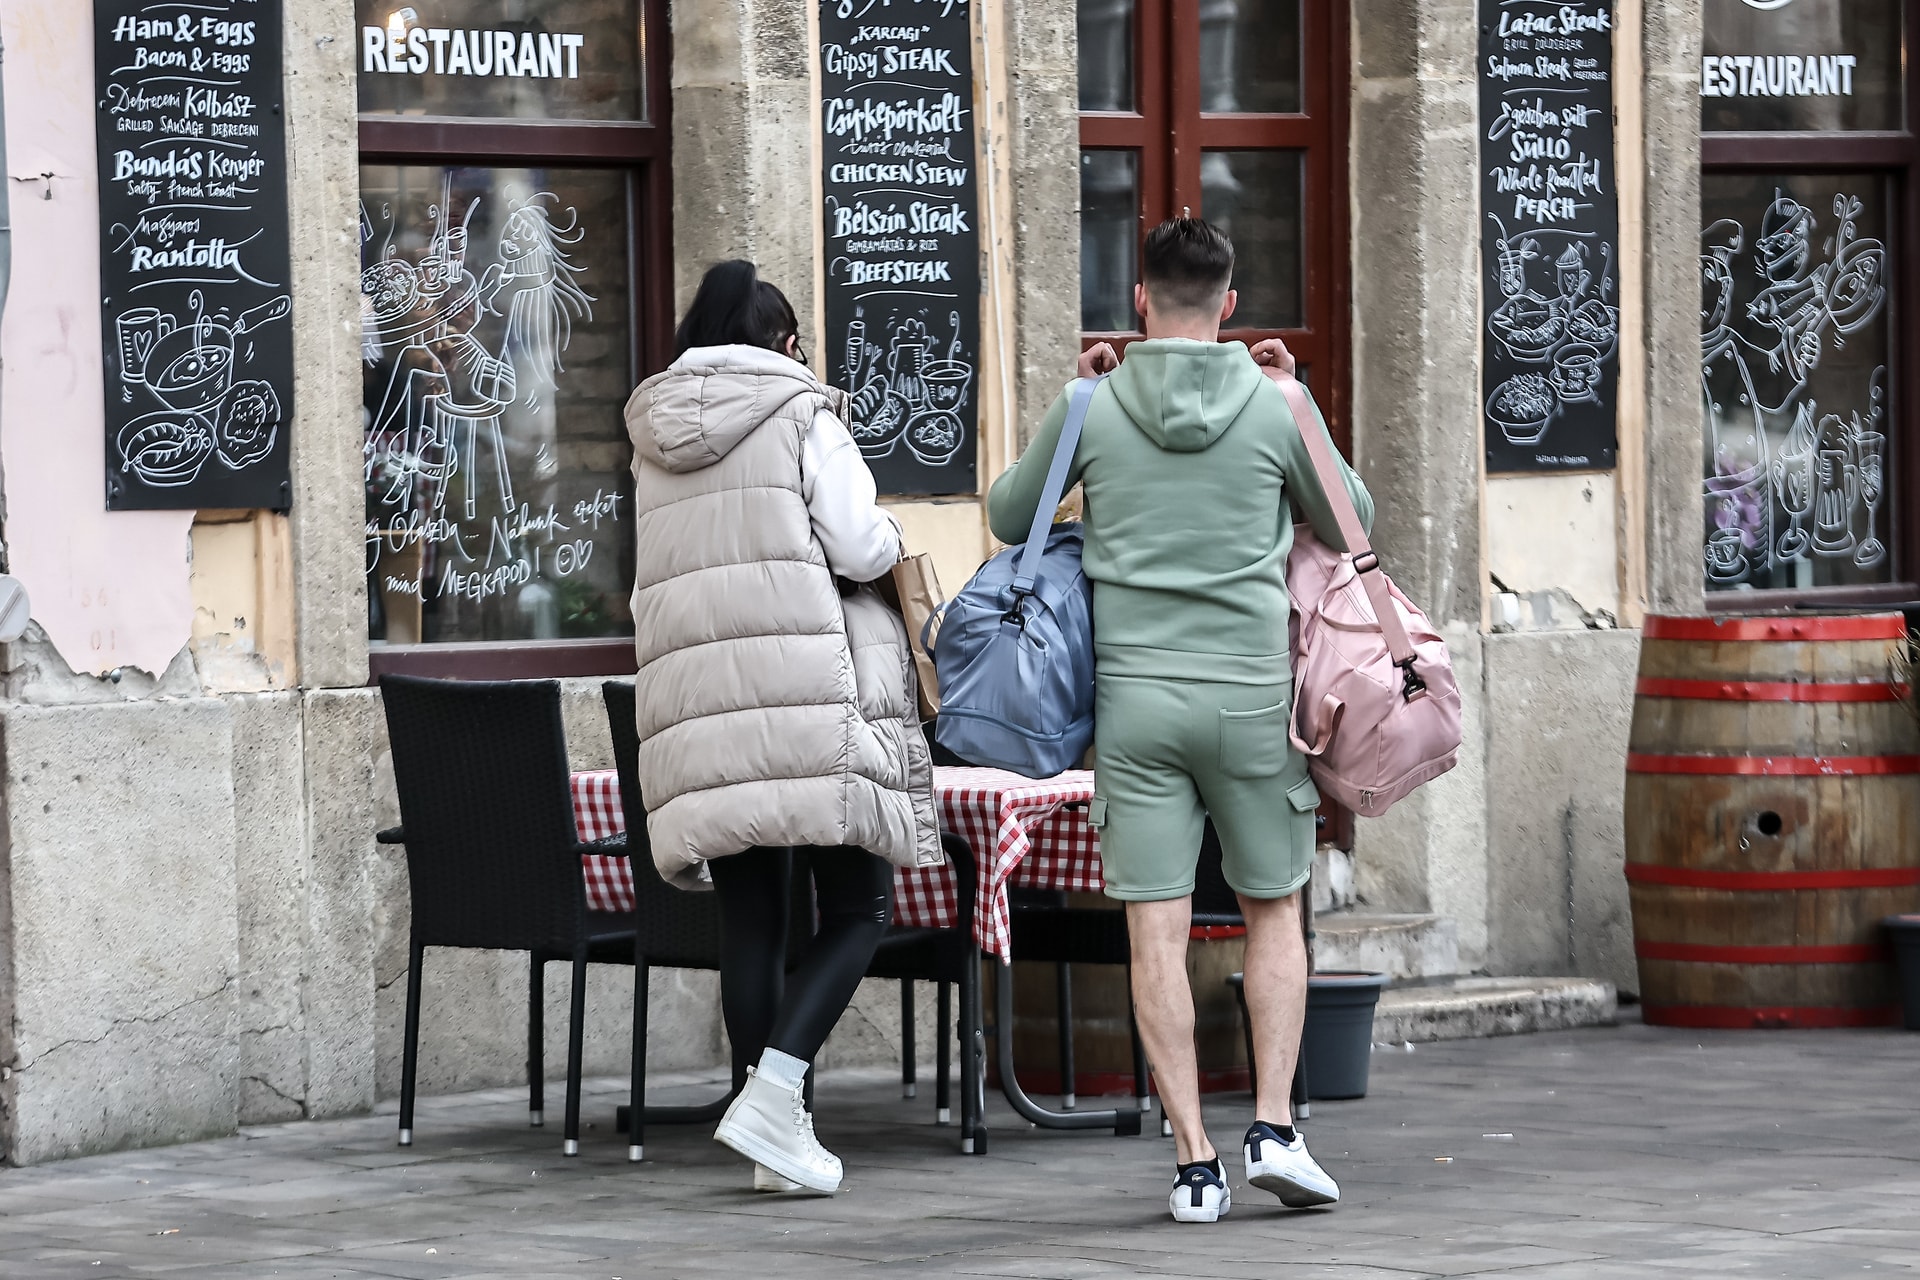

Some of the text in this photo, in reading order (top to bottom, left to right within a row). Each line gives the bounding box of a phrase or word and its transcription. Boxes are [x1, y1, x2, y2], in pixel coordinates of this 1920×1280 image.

[111, 14, 256, 46] Ham & Eggs
[1558, 5, 1612, 37] Steak
[122, 47, 250, 74] Bacon & Eggs
[362, 25, 584, 79] RESTAURANT
[821, 43, 878, 80] Gipsy
[1486, 54, 1573, 82] Salmon Steak
[1700, 55, 1856, 97] ESTAURANT
[106, 83, 257, 119] Debreceni Kolbász
[117, 117, 154, 133] GRILLED
[211, 122, 260, 138] DEBRECENI
[111, 147, 265, 182] Bundás Kenyér
[829, 158, 967, 186] CHICKEN STEW
[1489, 163, 1543, 194] Whole
[127, 180, 163, 205] Salty
[828, 199, 970, 239] Bélszín Steak
[1514, 194, 1585, 224] PERCH
[125, 213, 200, 248] Magyaros
[385, 568, 427, 603] mind
